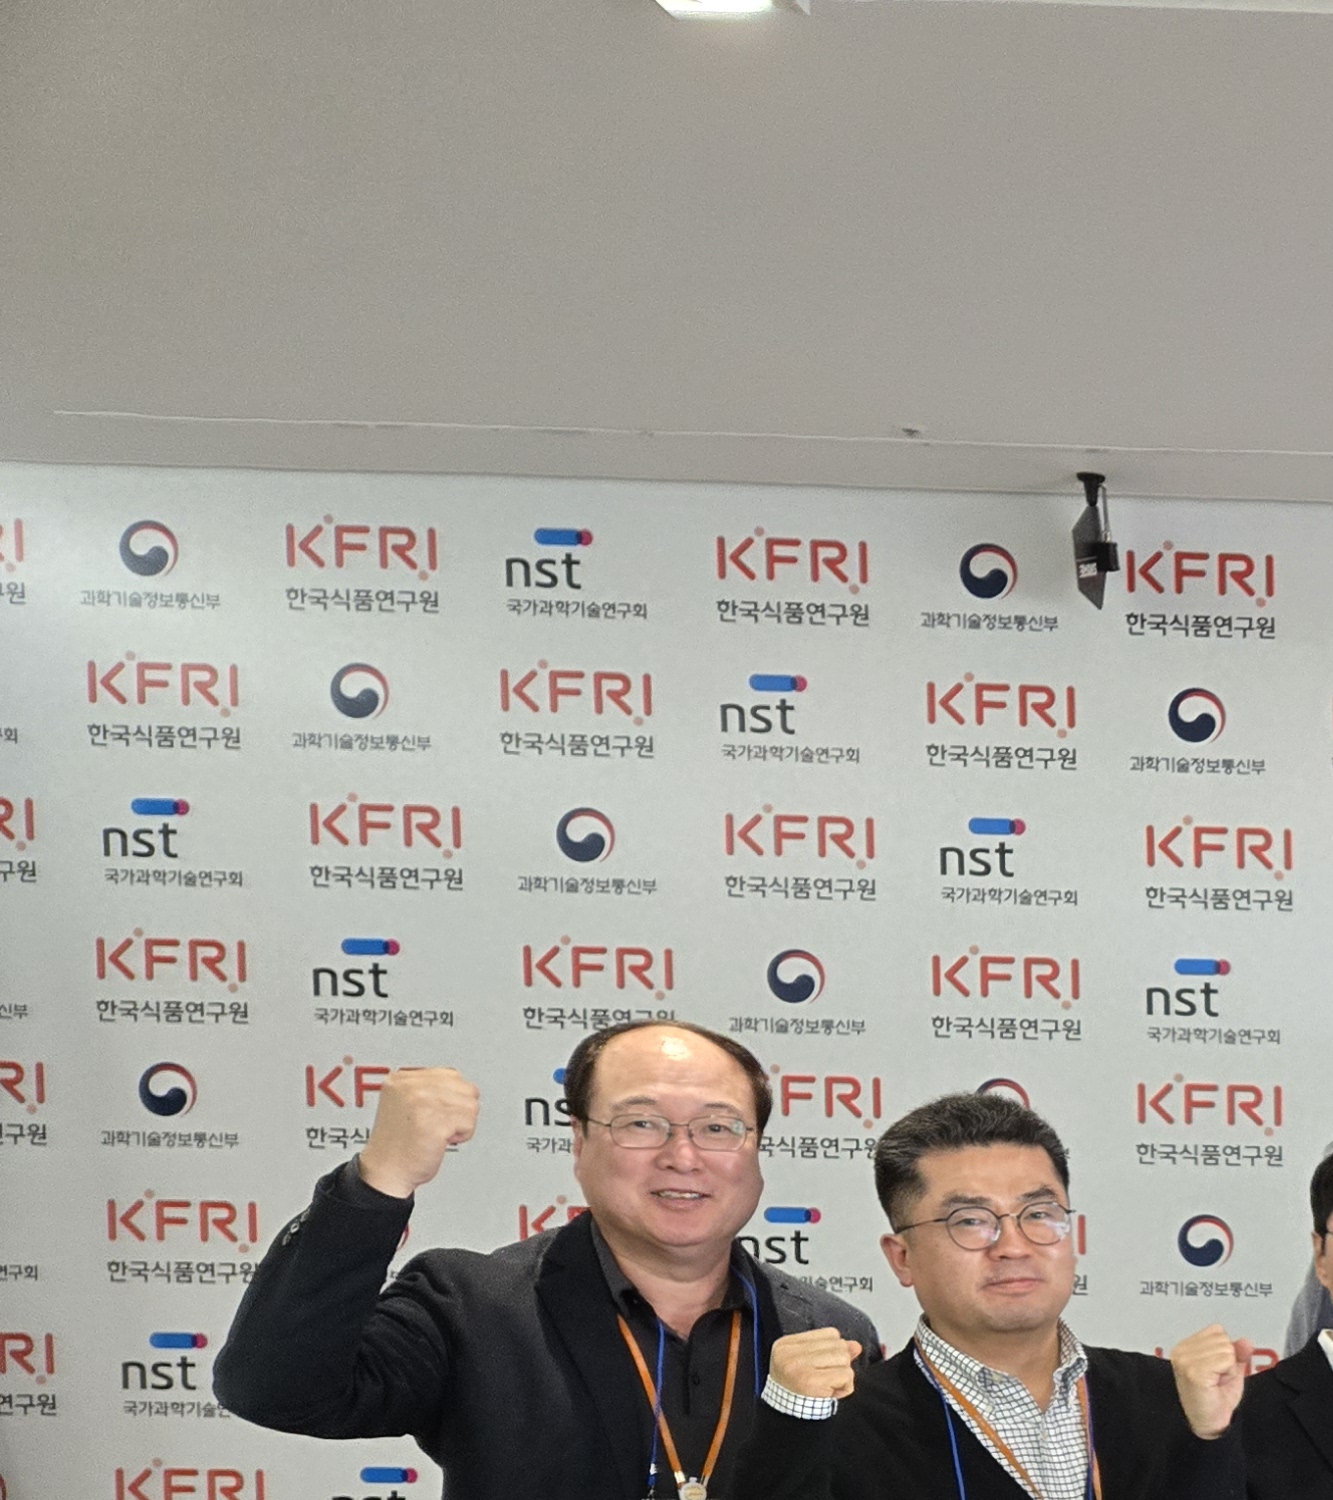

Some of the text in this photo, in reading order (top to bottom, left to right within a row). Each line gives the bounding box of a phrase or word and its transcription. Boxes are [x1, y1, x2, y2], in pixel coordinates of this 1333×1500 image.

[287, 526, 437, 571] KFRI
[717, 538, 868, 584] KFRI
[506, 553, 581, 589] nst
[1127, 552, 1274, 597] KFRI
[286, 588, 439, 614] 한국식품연구원
[508, 599, 647, 619] 국가과학기술연구회
[717, 600, 869, 627] 한국식품연구원
[922, 612, 1058, 632] 과학기술정보통신부
[1126, 613, 1275, 639] 한국식품연구원
[88, 663, 237, 706] KFRI
[501, 670, 652, 715] KFRI
[721, 699, 795, 735] nst
[928, 684, 1075, 727] KFRI
[88, 724, 240, 750] 한국식품연구원
[293, 733, 431, 751] 과학기술정보통신부
[501, 732, 654, 759] 한국식품연구원
[723, 744, 860, 764] 국가과학기술연구회
[927, 744, 1076, 770] 한국식품연구원
[1131, 756, 1265, 775] 과학기술정보통신부
[312, 804, 461, 847] KFRI
[725, 815, 875, 858] KFRI
[103, 823, 178, 858] nst
[1146, 827, 1292, 868] KFRI
[940, 842, 1014, 877] nst
[106, 869, 243, 887] 국가과학기술연구회
[310, 865, 463, 891] 한국식품연구원
[519, 876, 656, 895] 과학기술정보통신부
[725, 876, 876, 901] 한국식품연구원
[942, 887, 1078, 906] 국가과학기술연구회
[1146, 887, 1293, 912] 한국식품연구원
[97, 939, 245, 980] KFRI
[524, 947, 672, 988] KFRI
[313, 963, 388, 998] nst
[933, 956, 1079, 997] KFRI
[96, 1000, 248, 1024] 한국식품연구원
[1147, 983, 1218, 1017] nst
[315, 1008, 453, 1027] 국가과학기술연구회
[728, 1016, 867, 1036] 과학기술정보통신부
[932, 1016, 1081, 1041] 한국식품연구원
[1148, 1027, 1280, 1045] 국가과학기술연구회
[1138, 1083, 1282, 1126] KFRI
[101, 1131, 238, 1148] 과학기술정보통신부
[1136, 1143, 1282, 1167] 한국식품연구원
[108, 1201, 258, 1242] KFRI
[1140, 1281, 1272, 1297] 과학기술정보통신부
[122, 1356, 196, 1390] nst
